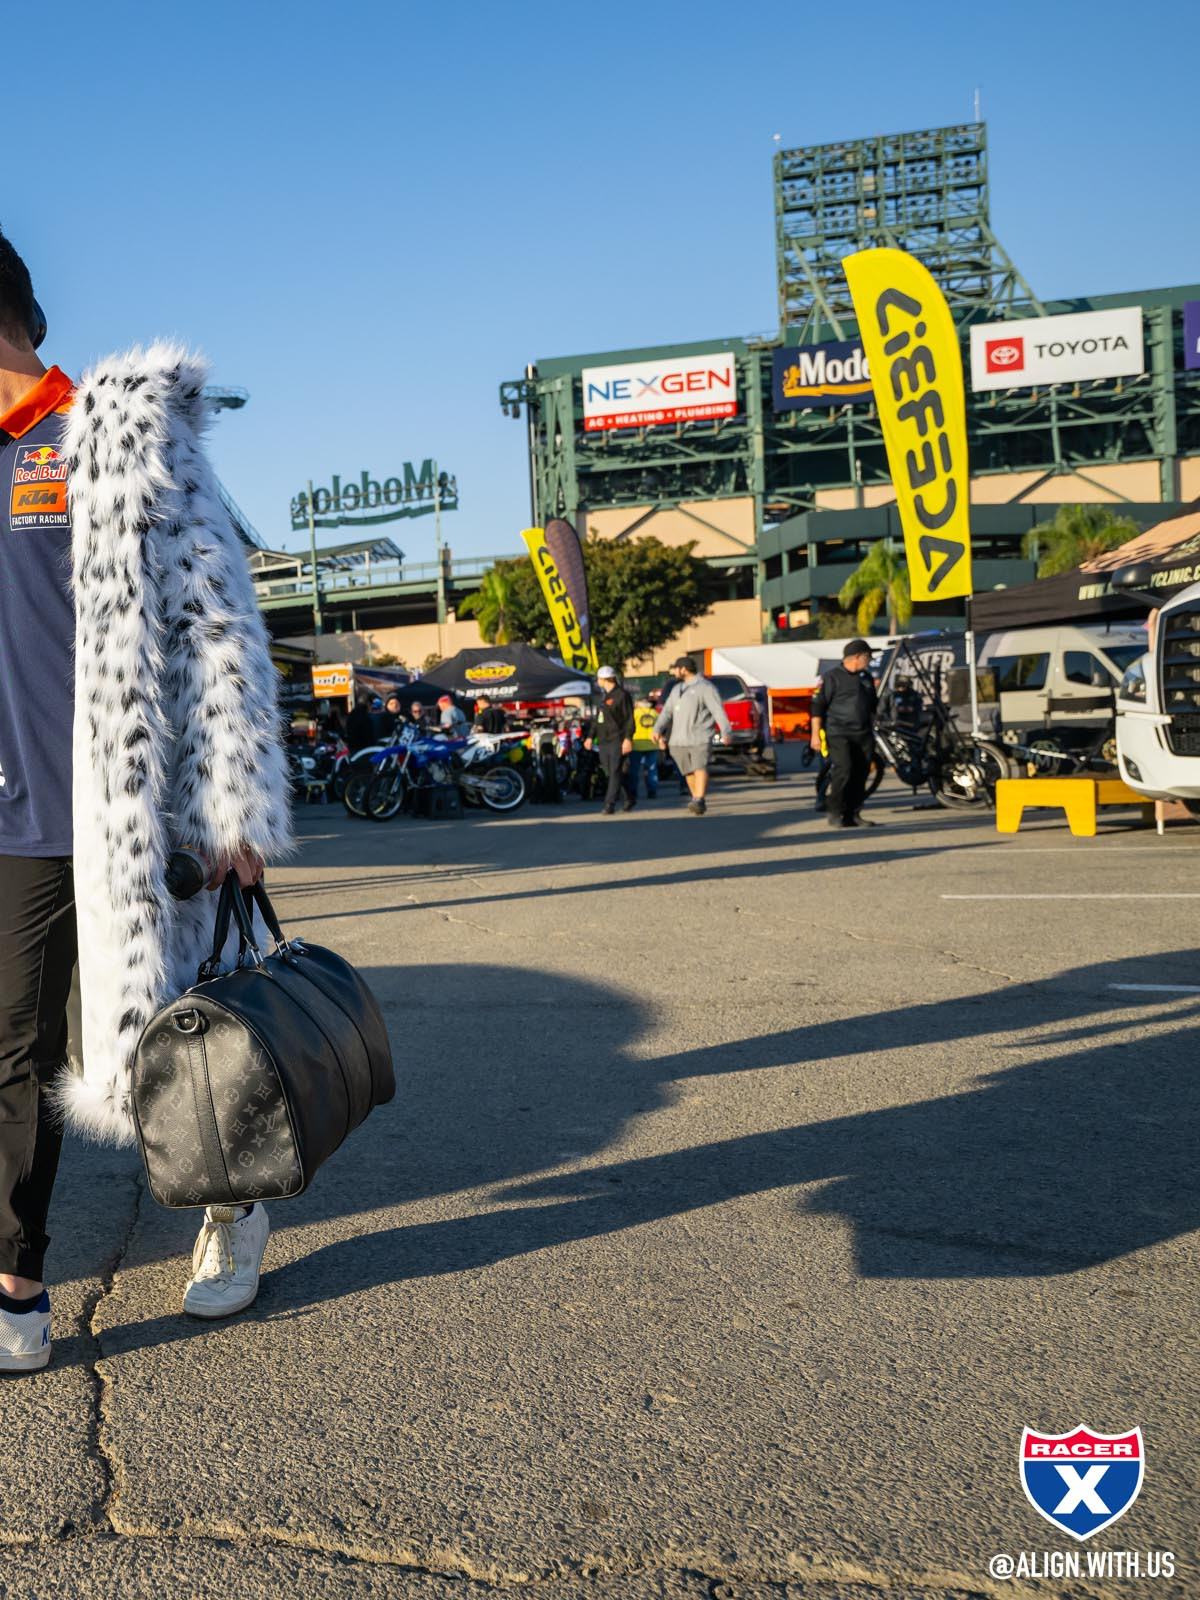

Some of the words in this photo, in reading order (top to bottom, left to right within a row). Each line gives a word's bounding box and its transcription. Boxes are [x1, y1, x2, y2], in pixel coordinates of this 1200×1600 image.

[1034, 336, 1129, 358] TOYOTA
[588, 368, 730, 403] NEXGEN
[588, 418, 605, 427] AC
[616, 411, 665, 425] HEATING
[675, 405, 733, 419] PLUMBING
[15, 466, 40, 483] Red
[40, 464, 68, 480] Bull
[17, 490, 59, 506] KTM
[12, 515, 37, 526] FACTORY
[40, 514, 68, 525] RACING
[466, 685, 519, 698] DUNLOP
